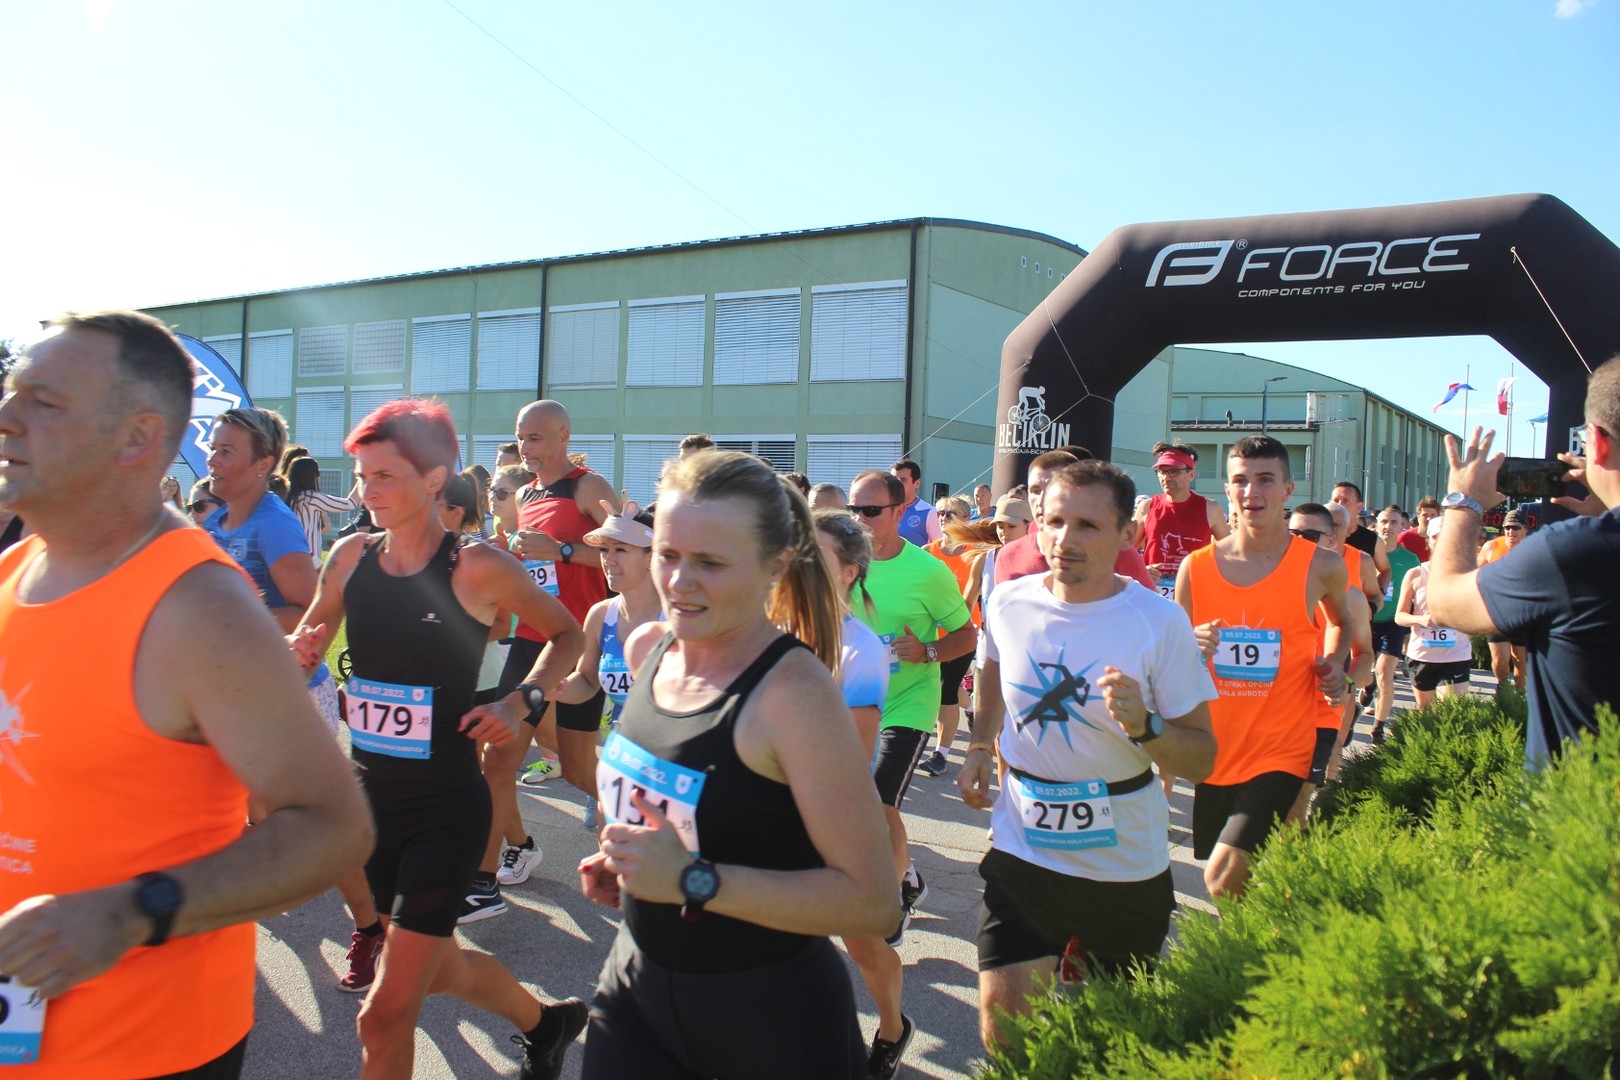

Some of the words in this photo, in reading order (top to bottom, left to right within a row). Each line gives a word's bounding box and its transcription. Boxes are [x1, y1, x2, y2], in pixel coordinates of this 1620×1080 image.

[1237, 233, 1481, 283] FORCE
[1238, 285, 1345, 298] COMPONENTS
[1351, 283, 1386, 293] FOR
[1392, 280, 1426, 290] YOU
[1430, 629, 1447, 641] 16
[1230, 644, 1260, 666] 19
[358, 701, 412, 736] 179
[1033, 801, 1094, 830] 279
